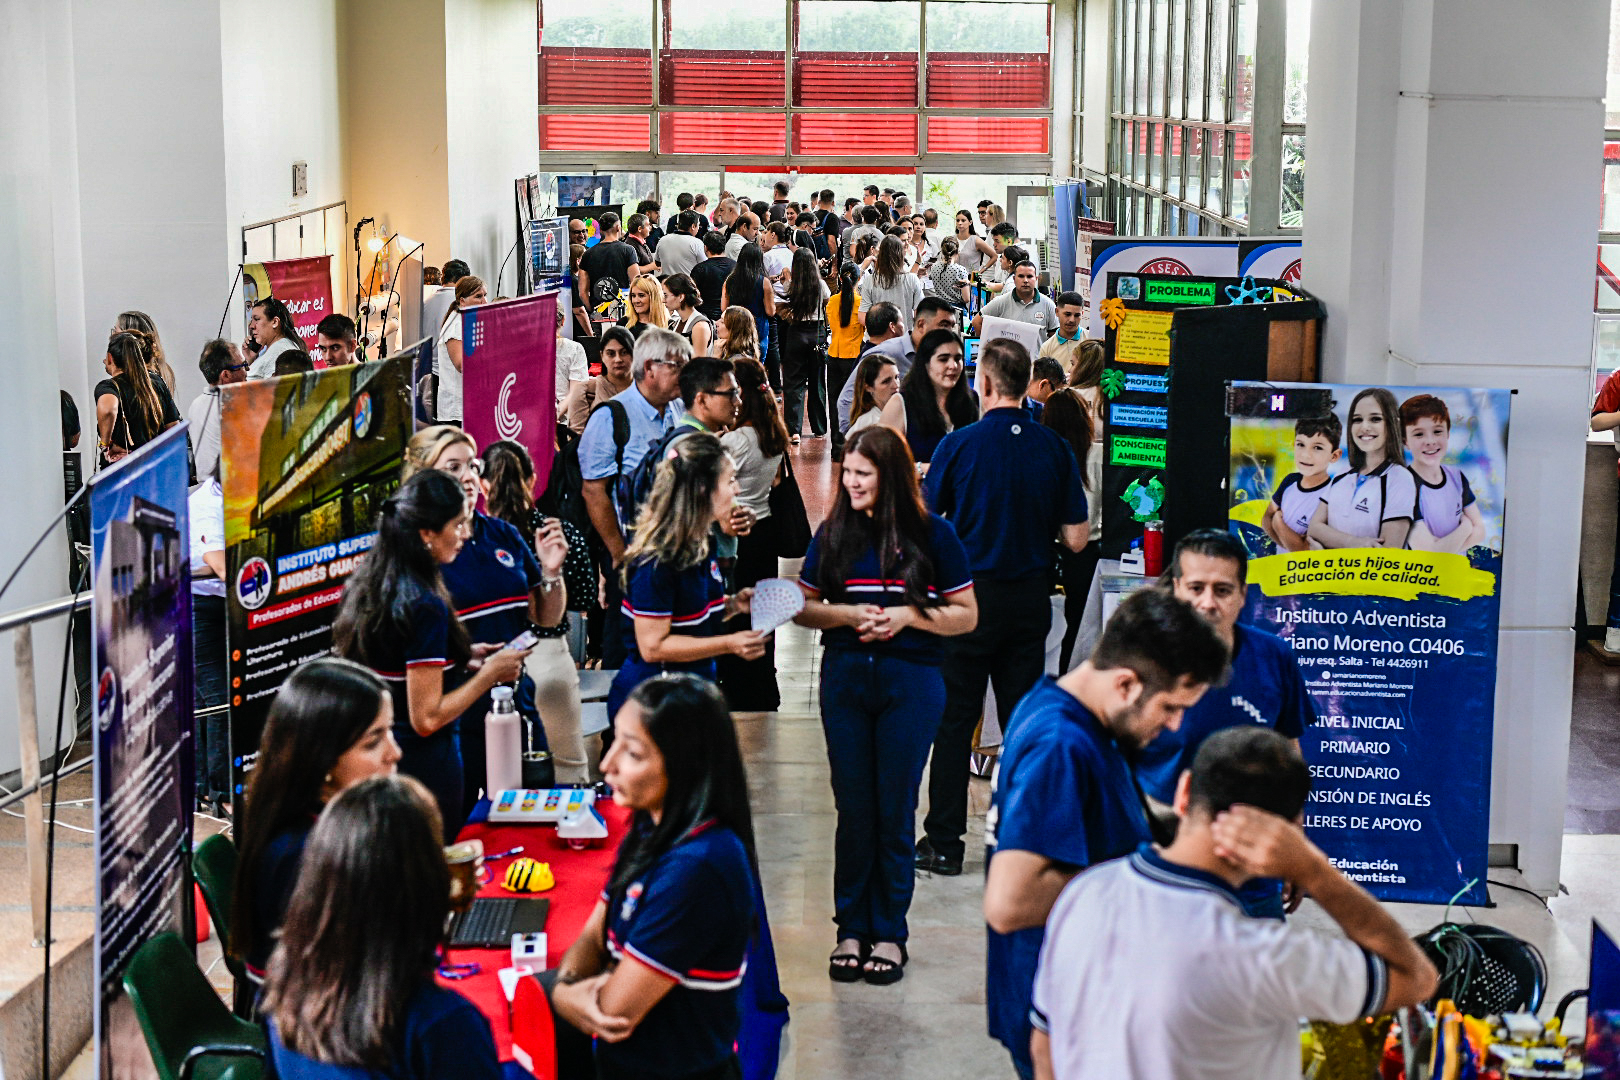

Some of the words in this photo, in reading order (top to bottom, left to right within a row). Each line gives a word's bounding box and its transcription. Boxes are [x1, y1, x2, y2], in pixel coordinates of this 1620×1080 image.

[1150, 286, 1211, 297] PROBLEMA
[1271, 395, 1285, 411] H
[278, 544, 336, 572] INSTITUTO
[1287, 558, 1320, 571] Dale
[1324, 558, 1334, 568] a
[1338, 557, 1361, 567] tus
[1366, 557, 1400, 570] hijos
[1405, 562, 1434, 573] una
[278, 562, 326, 592] ANDRÉS
[1280, 569, 1355, 586] Educación
[1360, 570, 1378, 580] de
[1382, 572, 1440, 586] calidad.
[253, 602, 302, 624] Profesorados
[303, 599, 312, 608] de
[1275, 607, 1348, 624] Instituto
[1352, 610, 1446, 628] Adventista
[1334, 635, 1404, 653] Moreno
[1409, 638, 1464, 655] C0406
[1317, 657, 1337, 667] esq.
[1339, 656, 1362, 666] Salta
[1371, 658, 1385, 667] Tel
[1387, 659, 1428, 668] 4426911
[1352, 716, 1404, 729] INICIAL
[1320, 741, 1390, 754] PRIMARIO
[1308, 765, 1400, 780] SECUNDARIO
[1306, 788, 1354, 804] NSIÓN
[1358, 792, 1376, 804] DE
[1380, 791, 1430, 807] INGLÉS
[1351, 817, 1369, 829] DE
[1372, 818, 1422, 832] APOYO
[1328, 858, 1398, 871] Educación
